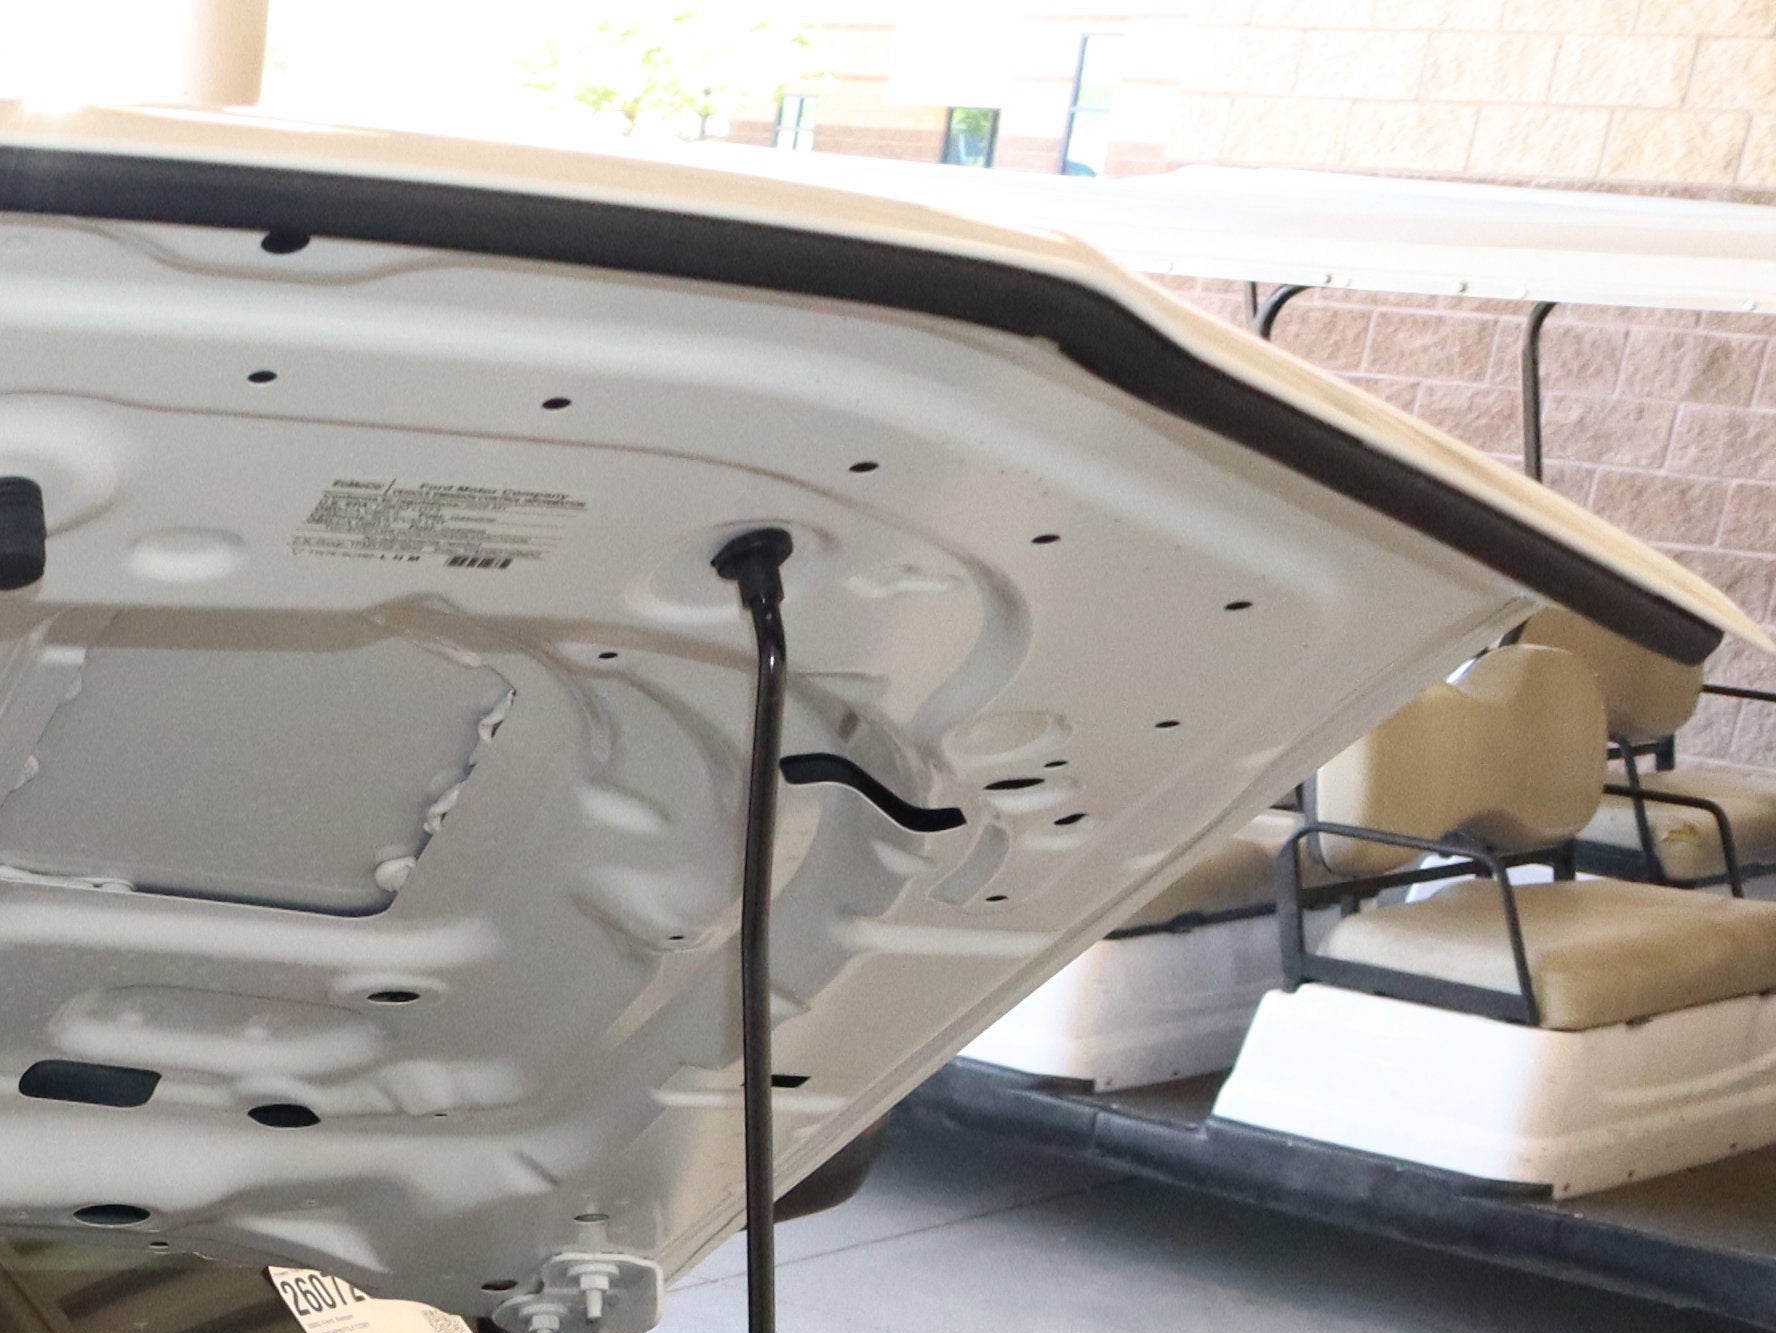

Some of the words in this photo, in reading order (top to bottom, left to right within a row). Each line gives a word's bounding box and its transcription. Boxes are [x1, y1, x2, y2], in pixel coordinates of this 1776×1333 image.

[419, 482, 454, 492] Ford
[457, 485, 497, 495] Motor
[502, 488, 570, 500] Company
